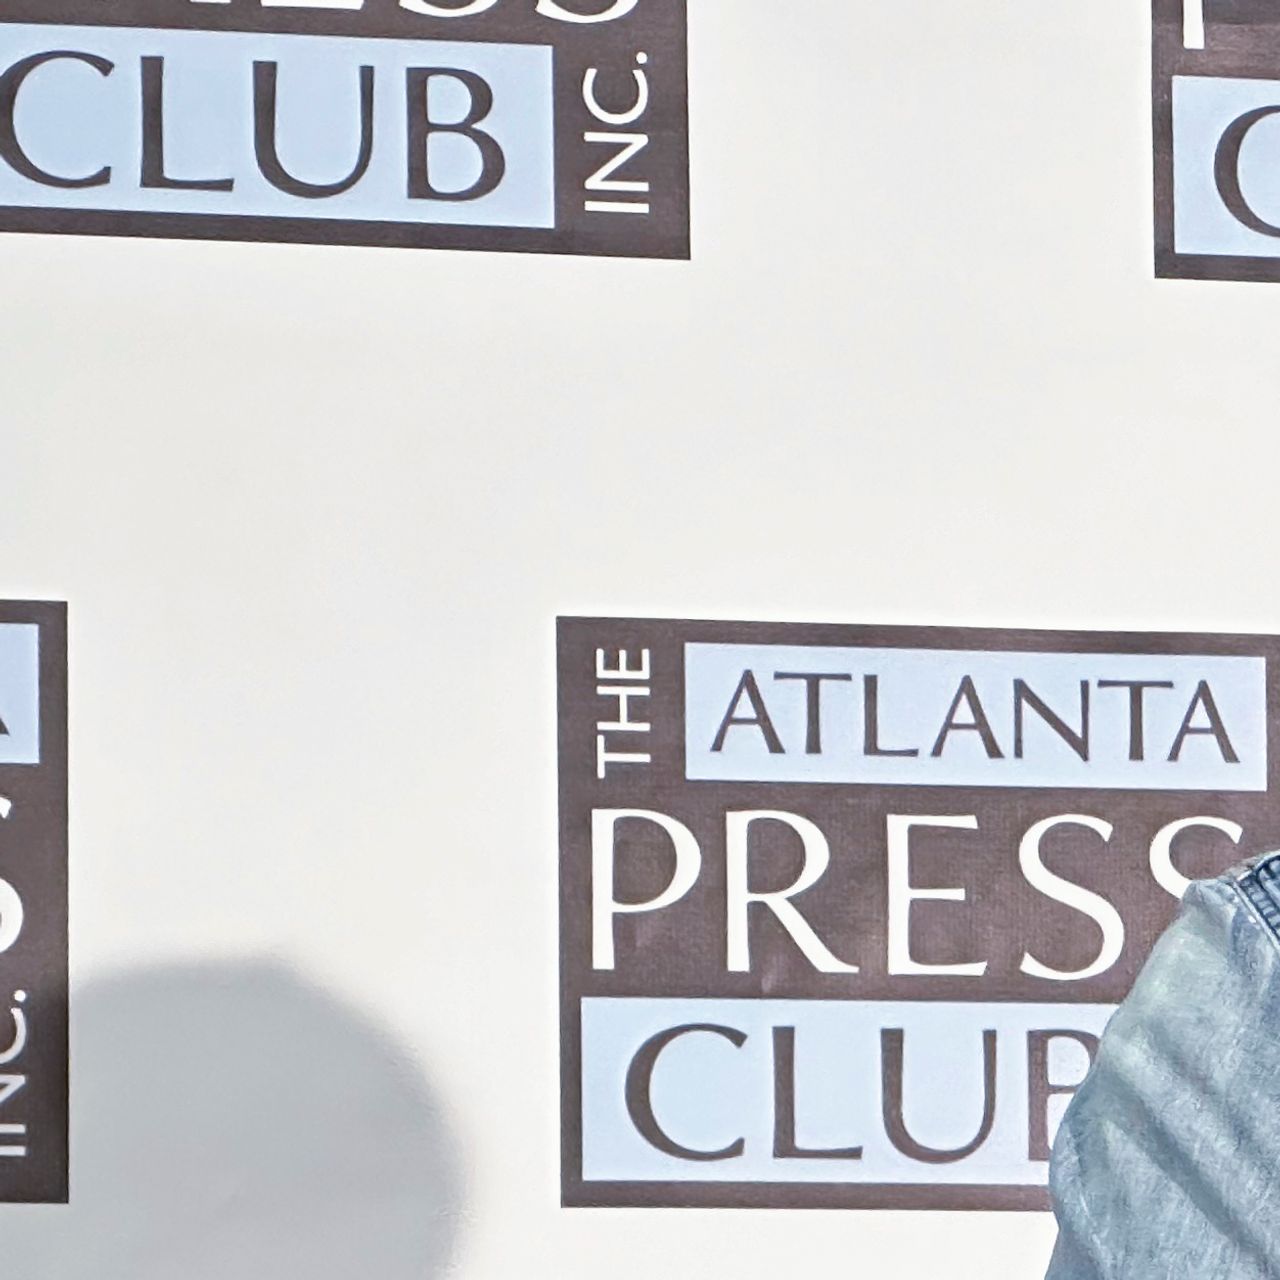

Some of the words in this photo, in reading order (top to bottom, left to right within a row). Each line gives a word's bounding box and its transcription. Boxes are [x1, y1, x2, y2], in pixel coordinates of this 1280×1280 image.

[0, 50, 506, 202] CLUB
[583, 51, 649, 214] INC.
[596, 648, 651, 779] THE
[710, 669, 1240, 763] ATLANTA
